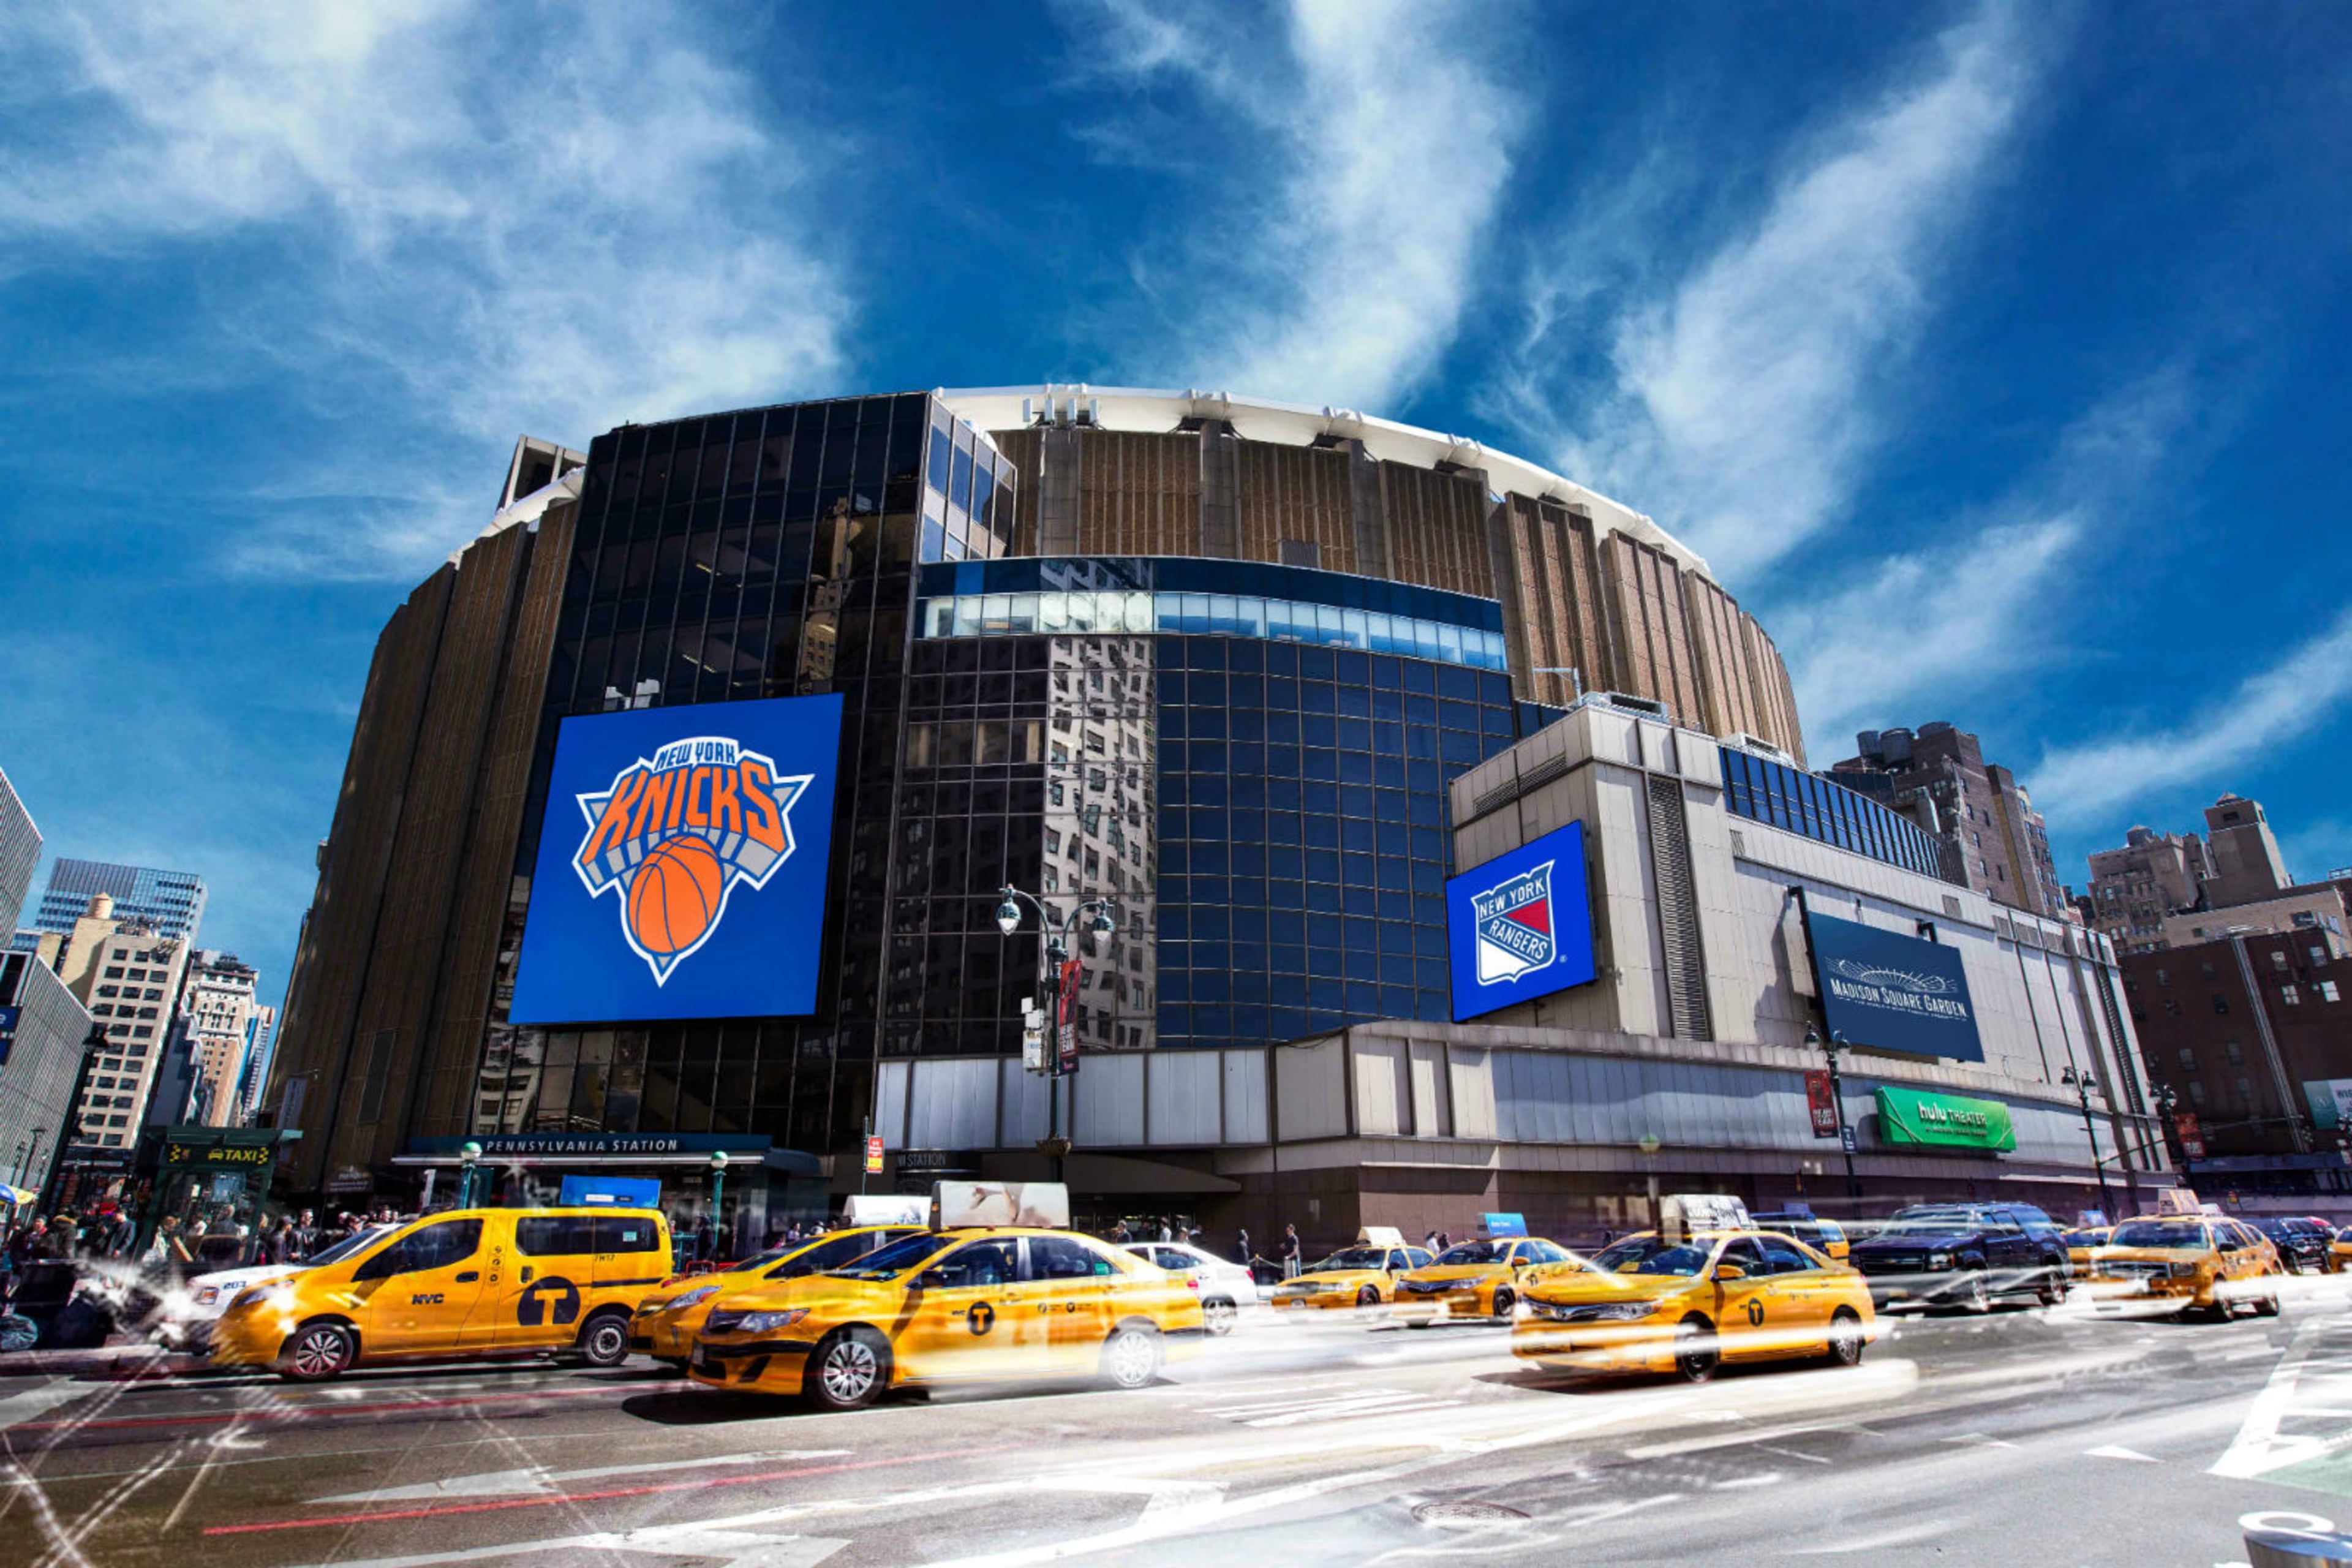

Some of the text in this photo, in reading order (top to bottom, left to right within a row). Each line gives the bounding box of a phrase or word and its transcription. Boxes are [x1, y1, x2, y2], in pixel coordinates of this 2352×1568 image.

[654, 741, 736, 771] NEW YORK
[581, 760, 786, 865] KNICKS
[1479, 878, 1545, 918] NEW YORK
[1488, 919, 1547, 960] RANGERS
[1830, 978, 1880, 1001] MADISON
[1880, 987, 1923, 1010] SQUARE
[1924, 995, 1968, 1017] GARDEN
[1917, 1100, 1986, 1126] hulu THEATER
[225, 1150, 258, 1161] TAXI
[487, 1139, 678, 1152] PENNSYLVANIA STATION
[907, 1153, 946, 1167] STATION
[412, 1294, 445, 1305] NYC
[533, 1289, 568, 1326] T
